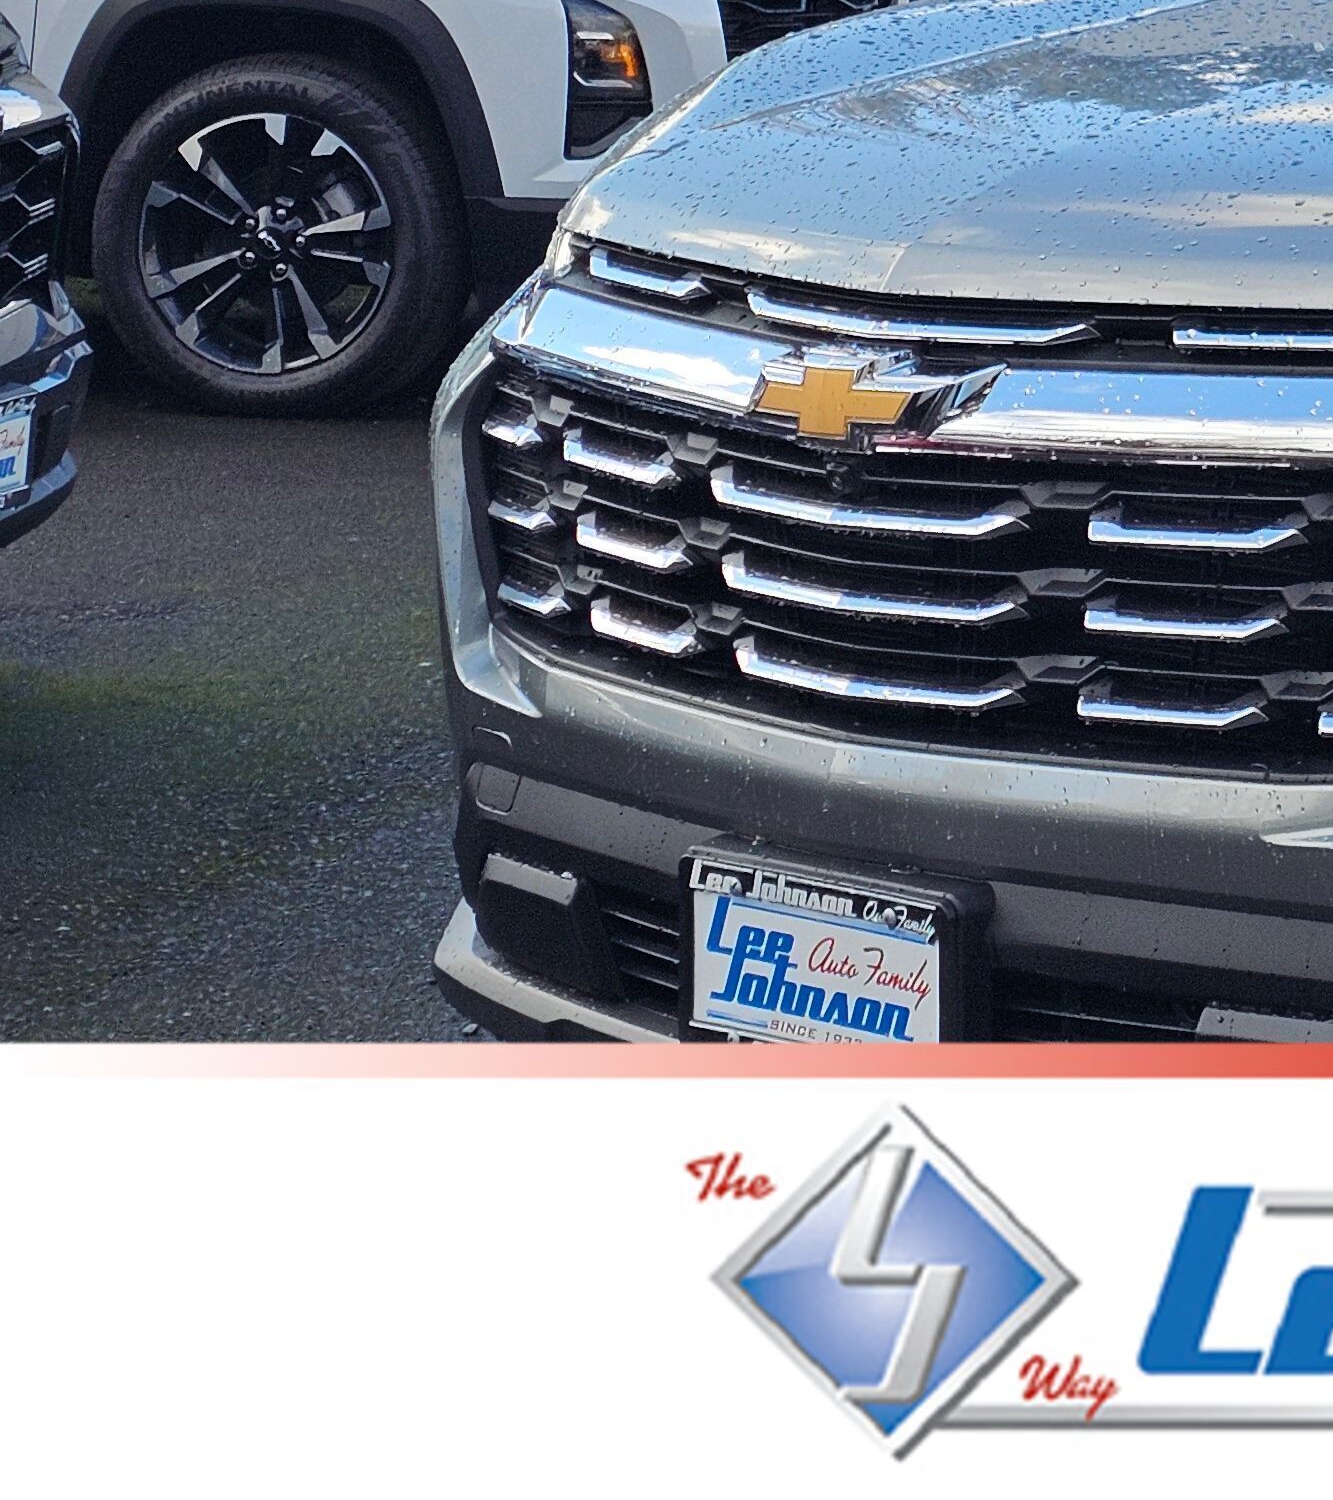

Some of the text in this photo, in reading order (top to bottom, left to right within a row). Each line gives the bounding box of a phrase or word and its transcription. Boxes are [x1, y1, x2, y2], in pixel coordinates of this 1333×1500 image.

[746, 868, 857, 918] Johnson
[706, 895, 914, 1042] Lee Johnson
[808, 937, 931, 1012] Auto Family
[769, 1018, 817, 1040] SINCE
